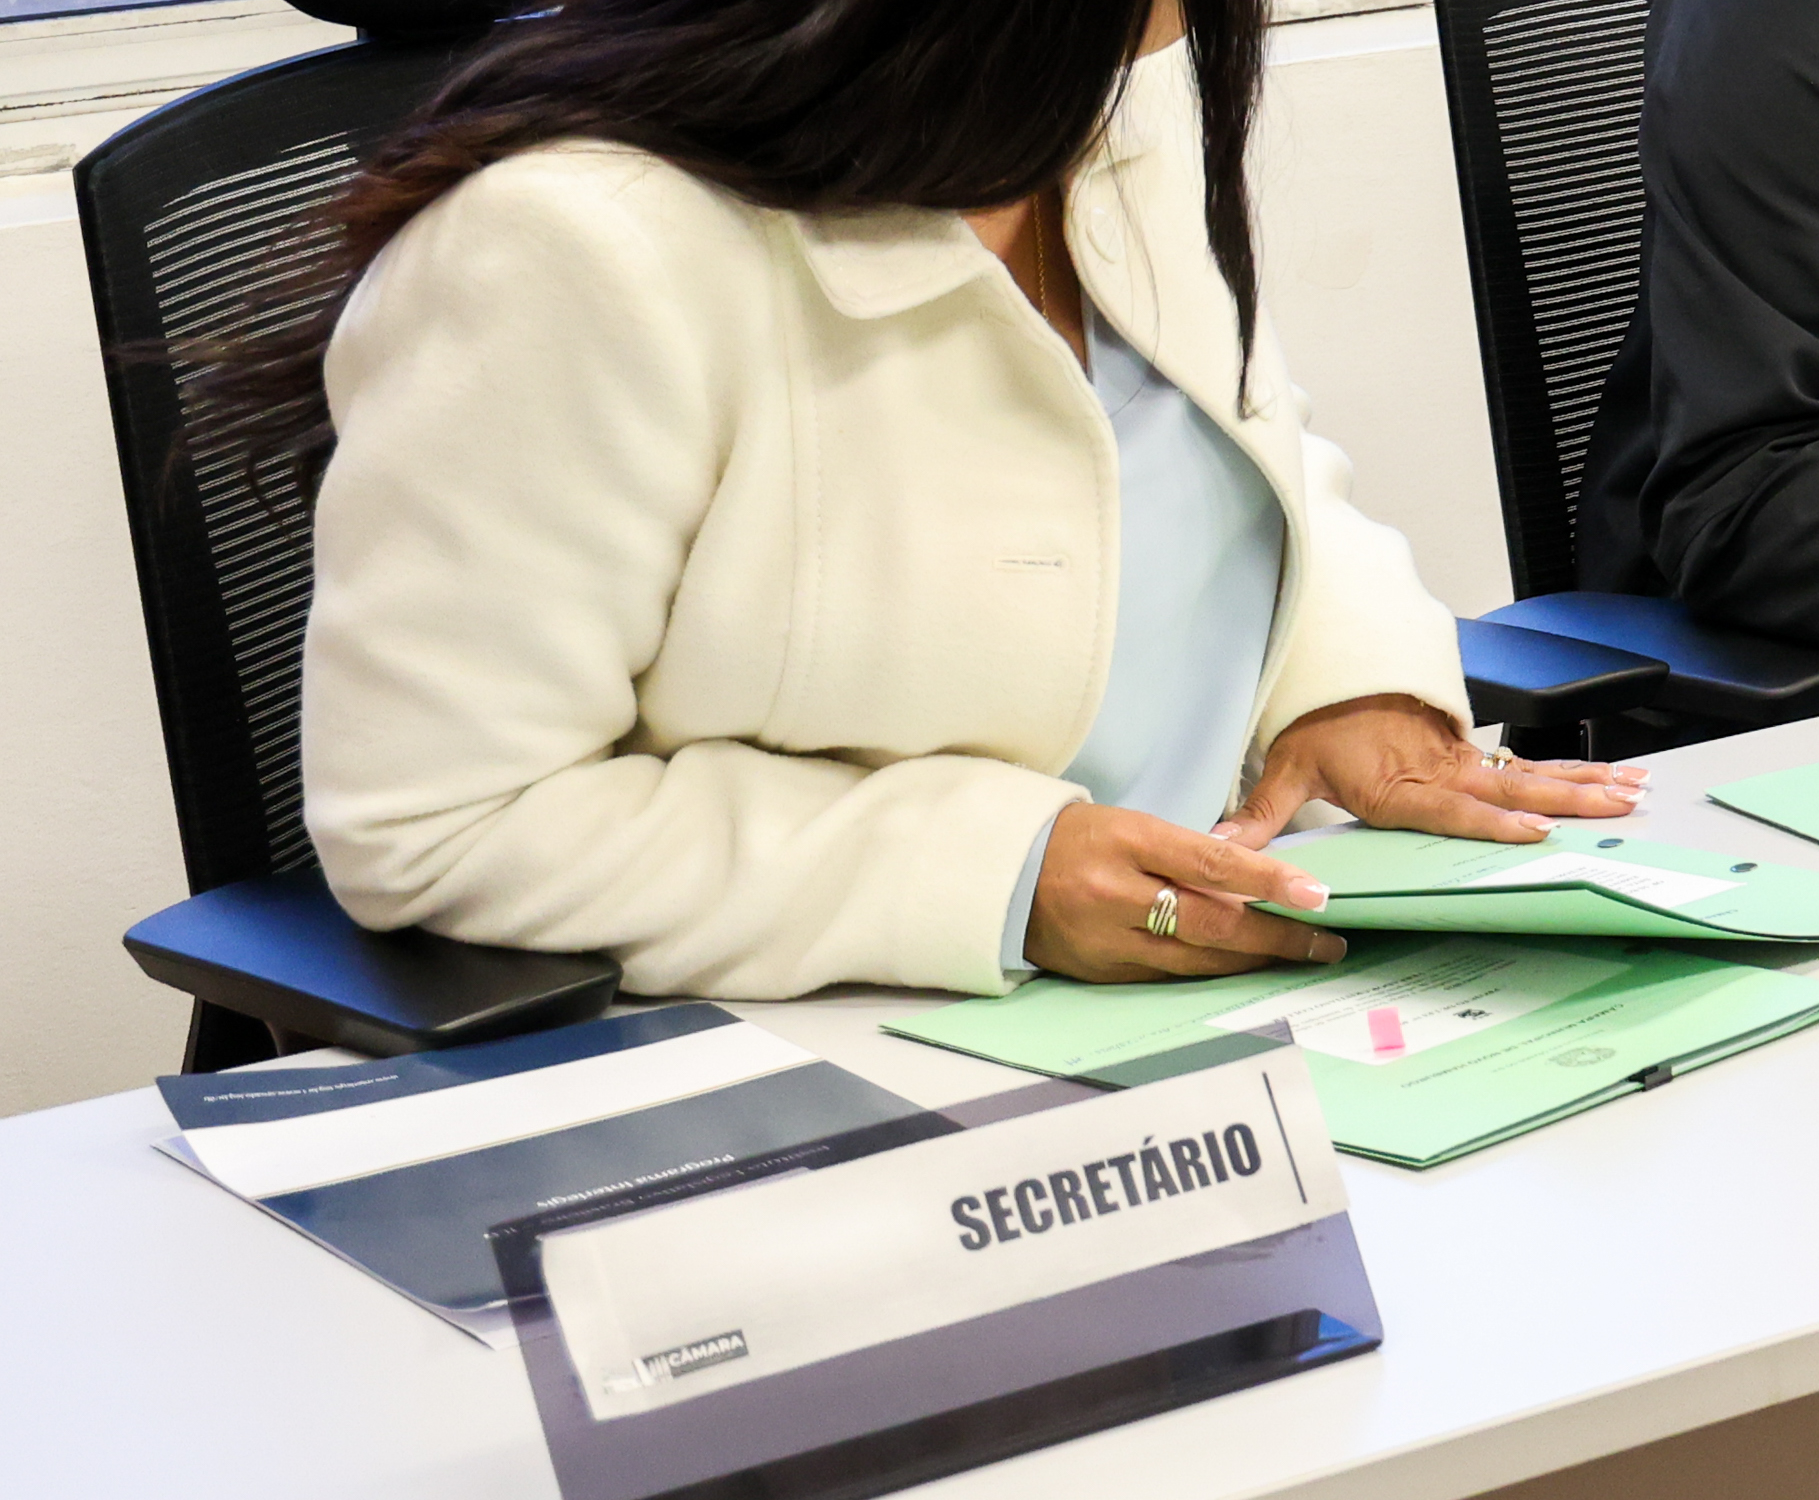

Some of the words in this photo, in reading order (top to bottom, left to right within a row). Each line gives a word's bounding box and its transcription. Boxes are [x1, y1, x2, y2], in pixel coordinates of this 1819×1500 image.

[636, 1153, 736, 1183] Programa
[536, 1179, 635, 1208] Interlegis
[951, 1122, 1263, 1251] SECRETÁRIO
